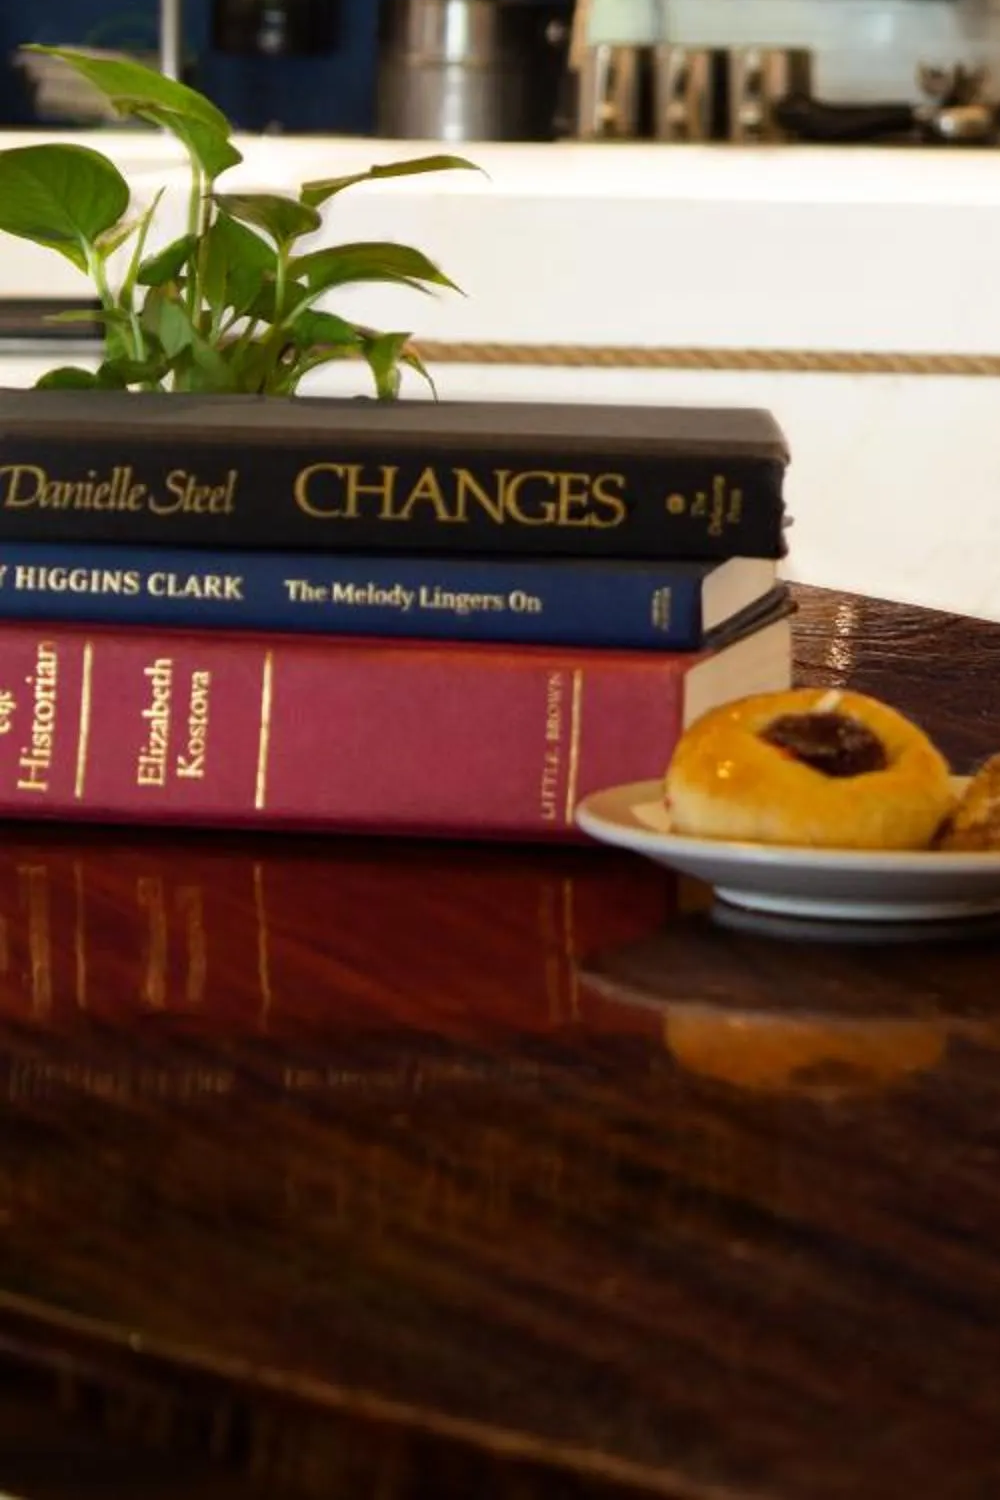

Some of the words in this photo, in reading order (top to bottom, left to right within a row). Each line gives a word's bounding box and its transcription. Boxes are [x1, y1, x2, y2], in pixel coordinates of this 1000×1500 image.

[0, 464, 146, 510] Danielle
[149, 468, 238, 515] Steel
[294, 462, 627, 528] CHANGES
[14, 564, 140, 594] HIGGINS
[146, 571, 244, 599] CLARK
[283, 579, 328, 603] The
[331, 581, 415, 612] Melody
[419, 585, 504, 615] Lingers
[507, 589, 543, 614] On
[16, 640, 58, 792] Historian
[137, 657, 173, 787] Elizabeth
[176, 670, 211, 778] Kostova
